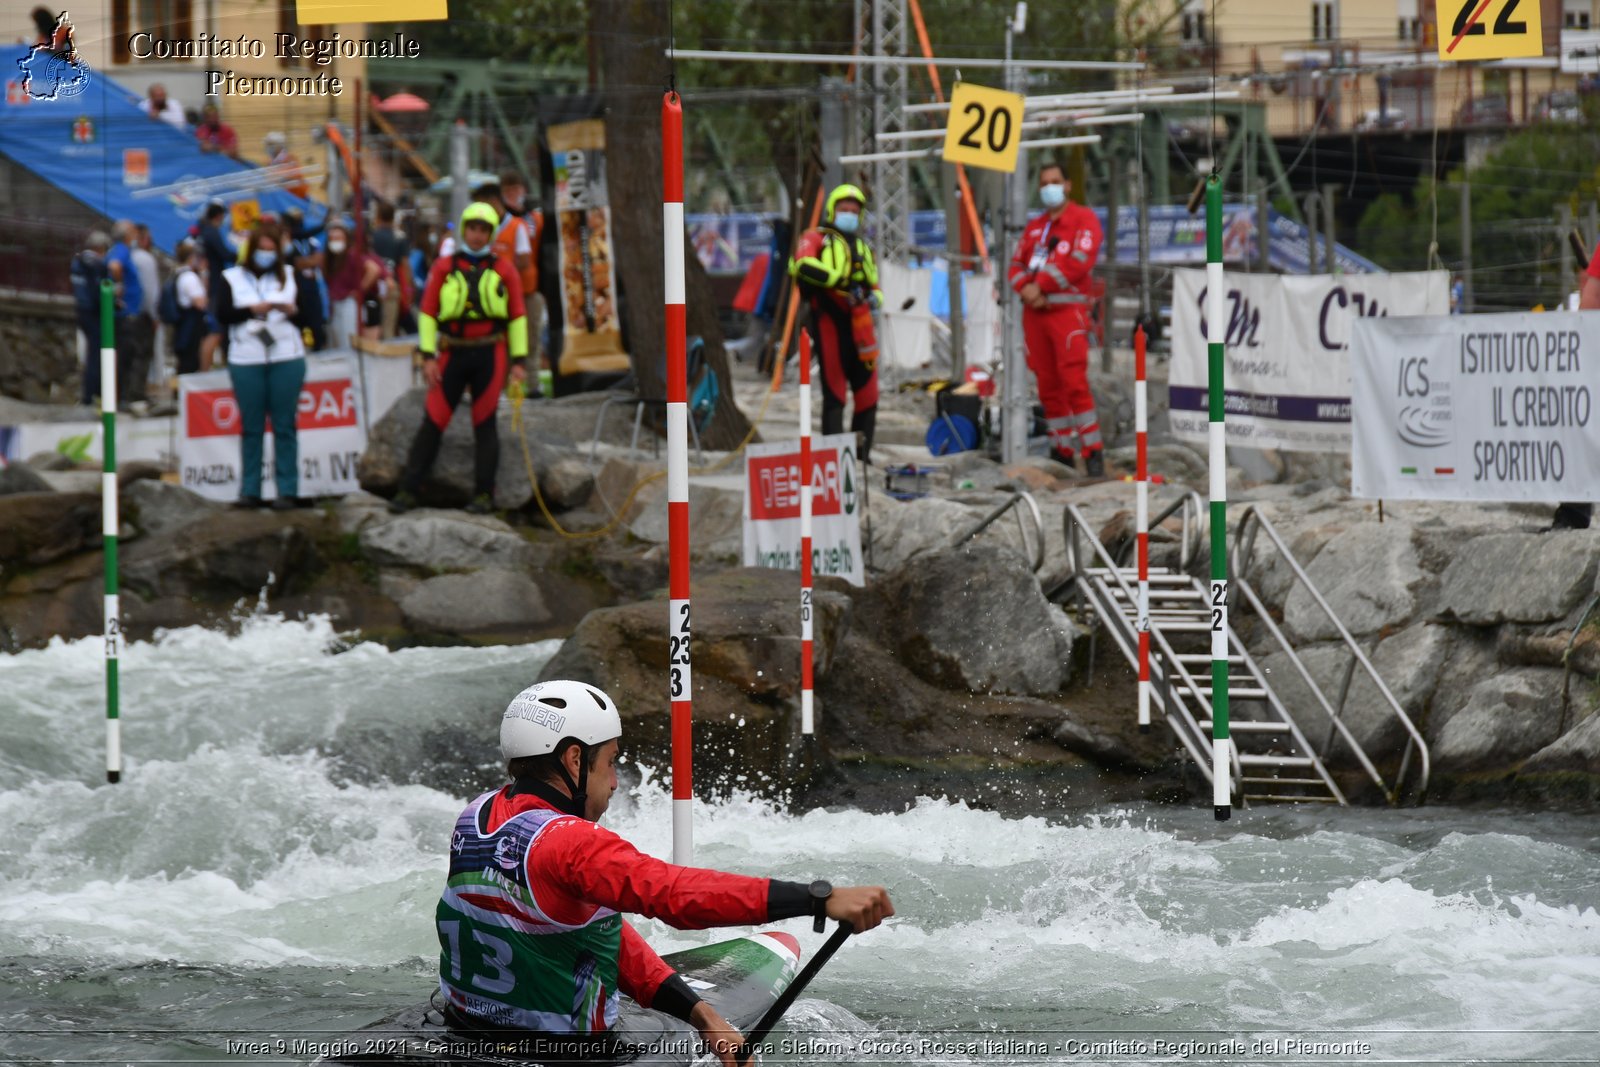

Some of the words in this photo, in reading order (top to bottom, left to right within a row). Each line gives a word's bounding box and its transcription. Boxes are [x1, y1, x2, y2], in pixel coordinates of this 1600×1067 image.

[958, 101, 1012, 153] 20
[1460, 331, 1540, 374] ISTITUTO
[1545, 331, 1581, 372] PER
[1398, 357, 1430, 397] ICS
[1493, 387, 1508, 427] IL
[1512, 385, 1591, 428] CREDITO
[1473, 440, 1565, 482] SPORTIVO
[760, 460, 839, 508] DESAR
[438, 920, 516, 995] 13
[467, 997, 514, 1019] REGIONE
